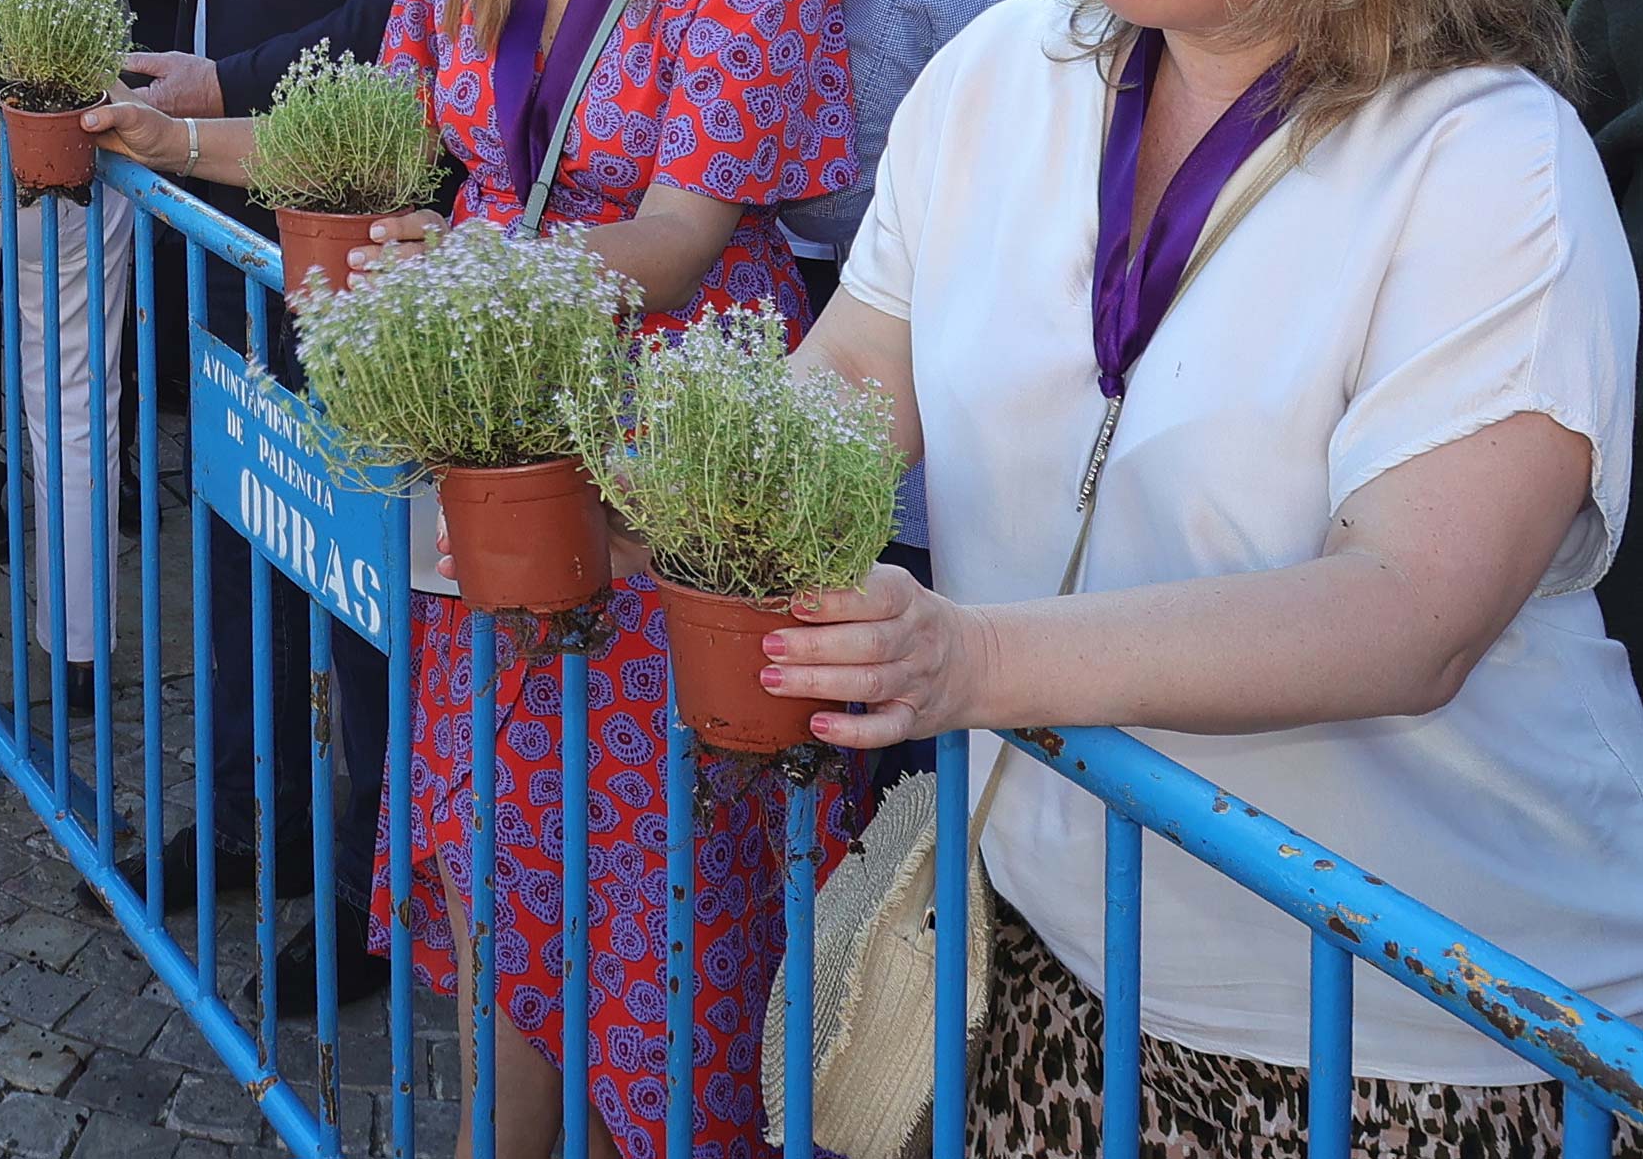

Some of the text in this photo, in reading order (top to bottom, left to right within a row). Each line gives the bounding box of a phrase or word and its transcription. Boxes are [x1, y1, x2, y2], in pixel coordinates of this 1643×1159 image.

[227, 407, 334, 517] DE PALENCIA
[240, 468, 381, 634] OBRAS
